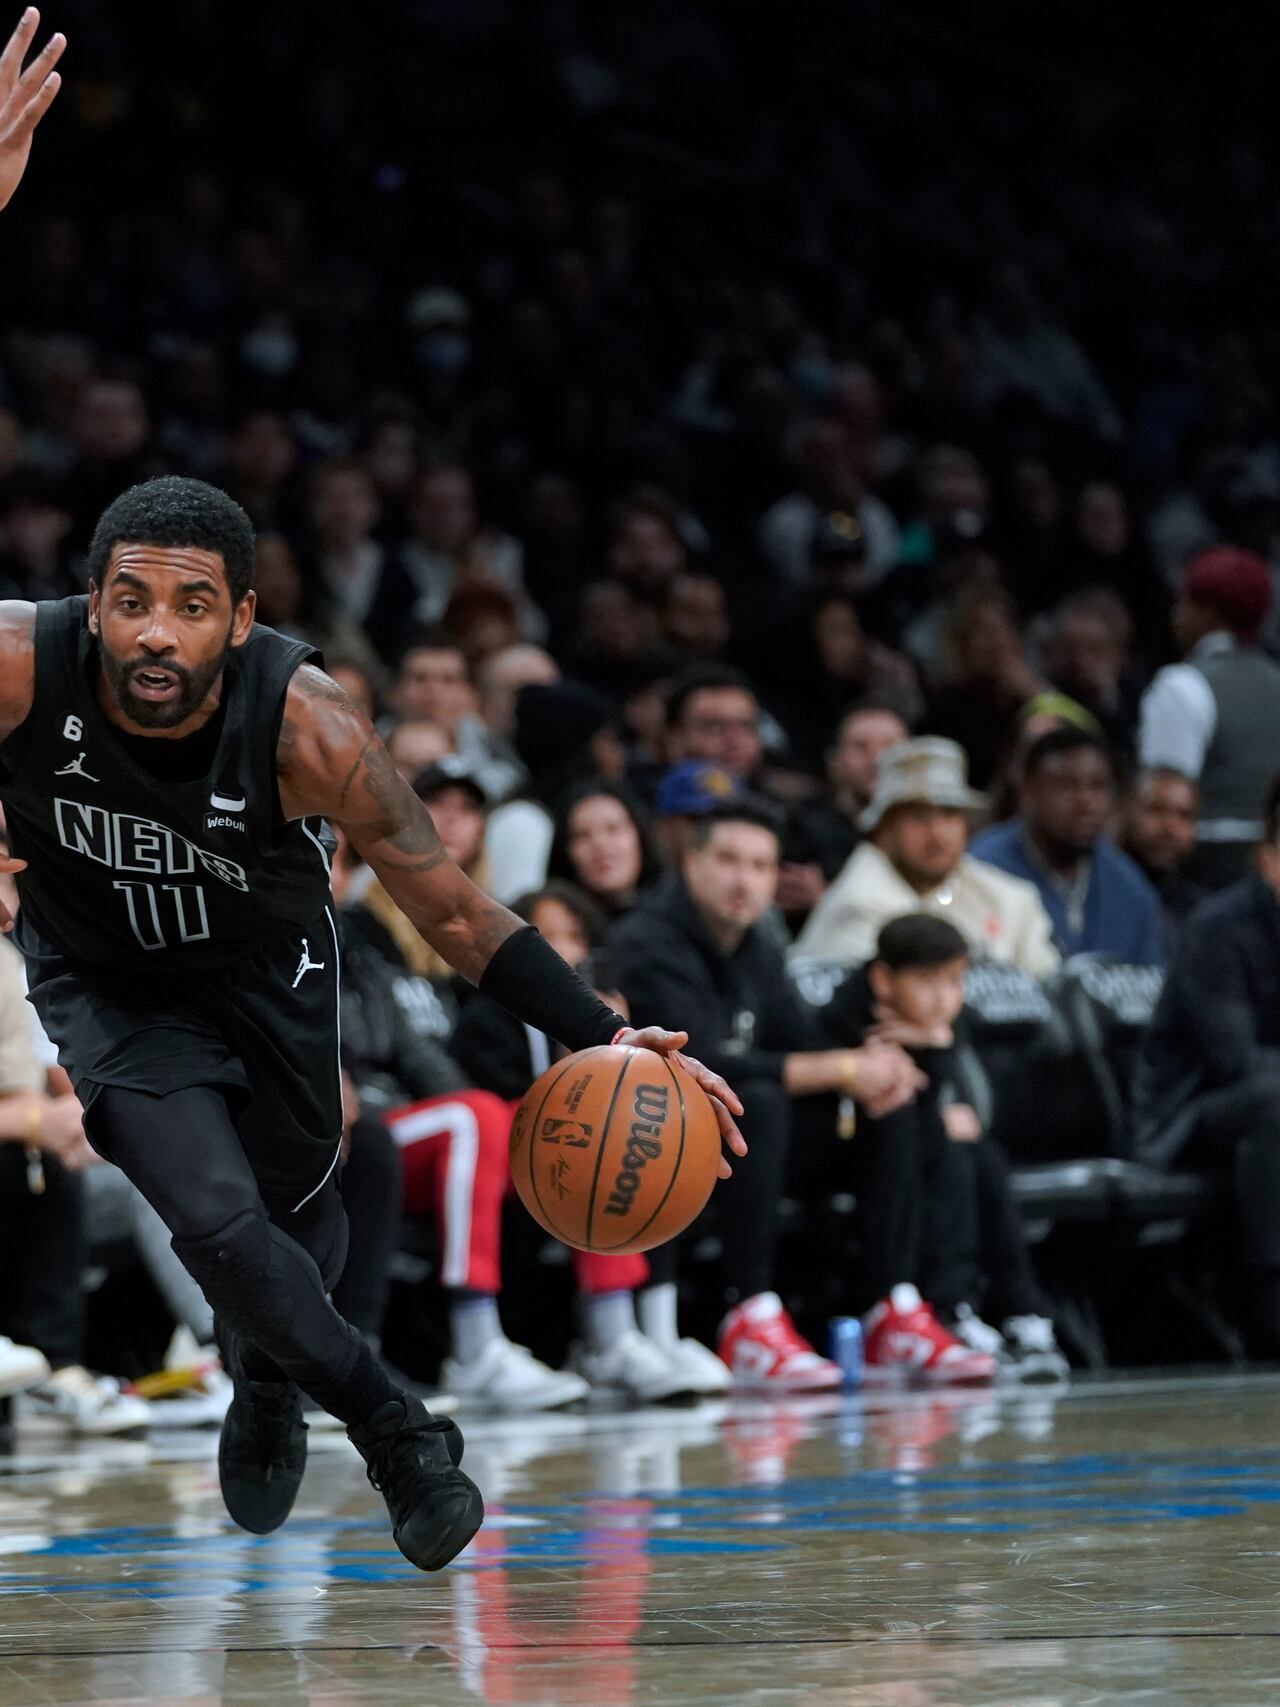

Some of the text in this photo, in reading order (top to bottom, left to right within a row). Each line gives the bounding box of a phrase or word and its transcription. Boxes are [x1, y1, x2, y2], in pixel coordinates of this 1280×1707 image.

[63, 714, 84, 742] 6
[54, 797, 250, 893] NETS
[207, 816, 246, 833] Webull
[112, 880, 211, 951] 11
[603, 1083, 669, 1217] Wilson
